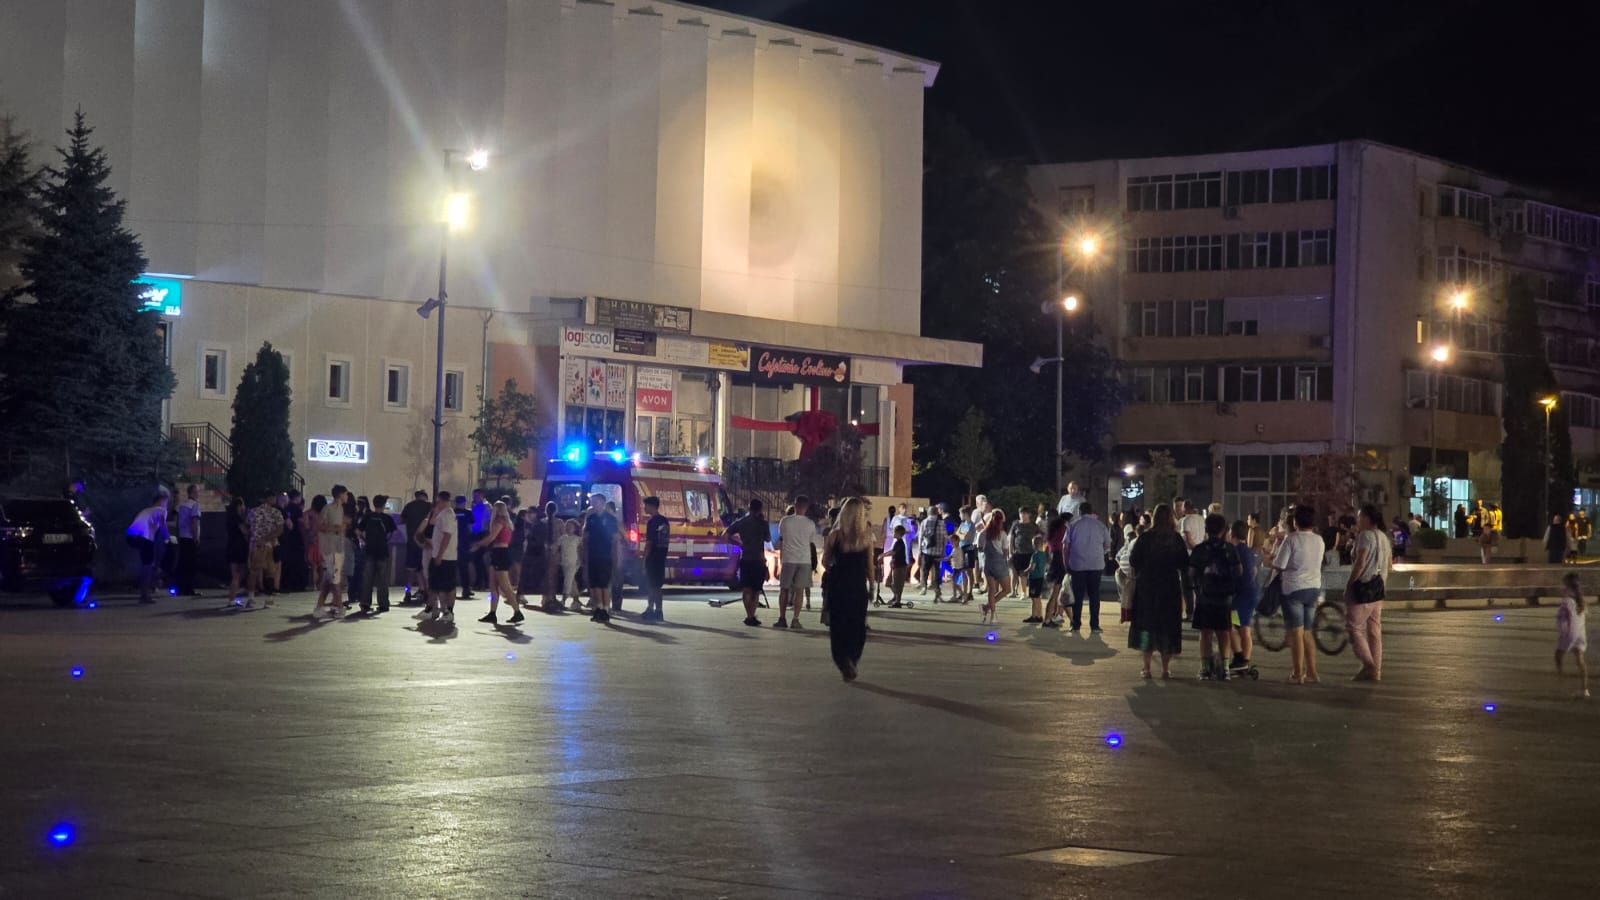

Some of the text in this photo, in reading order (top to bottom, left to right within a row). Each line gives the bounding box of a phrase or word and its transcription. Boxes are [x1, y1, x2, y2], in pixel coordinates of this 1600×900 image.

[564, 327, 612, 347] logiscool
[642, 395, 667, 406] AVON
[316, 441, 360, 459] ROYAL
